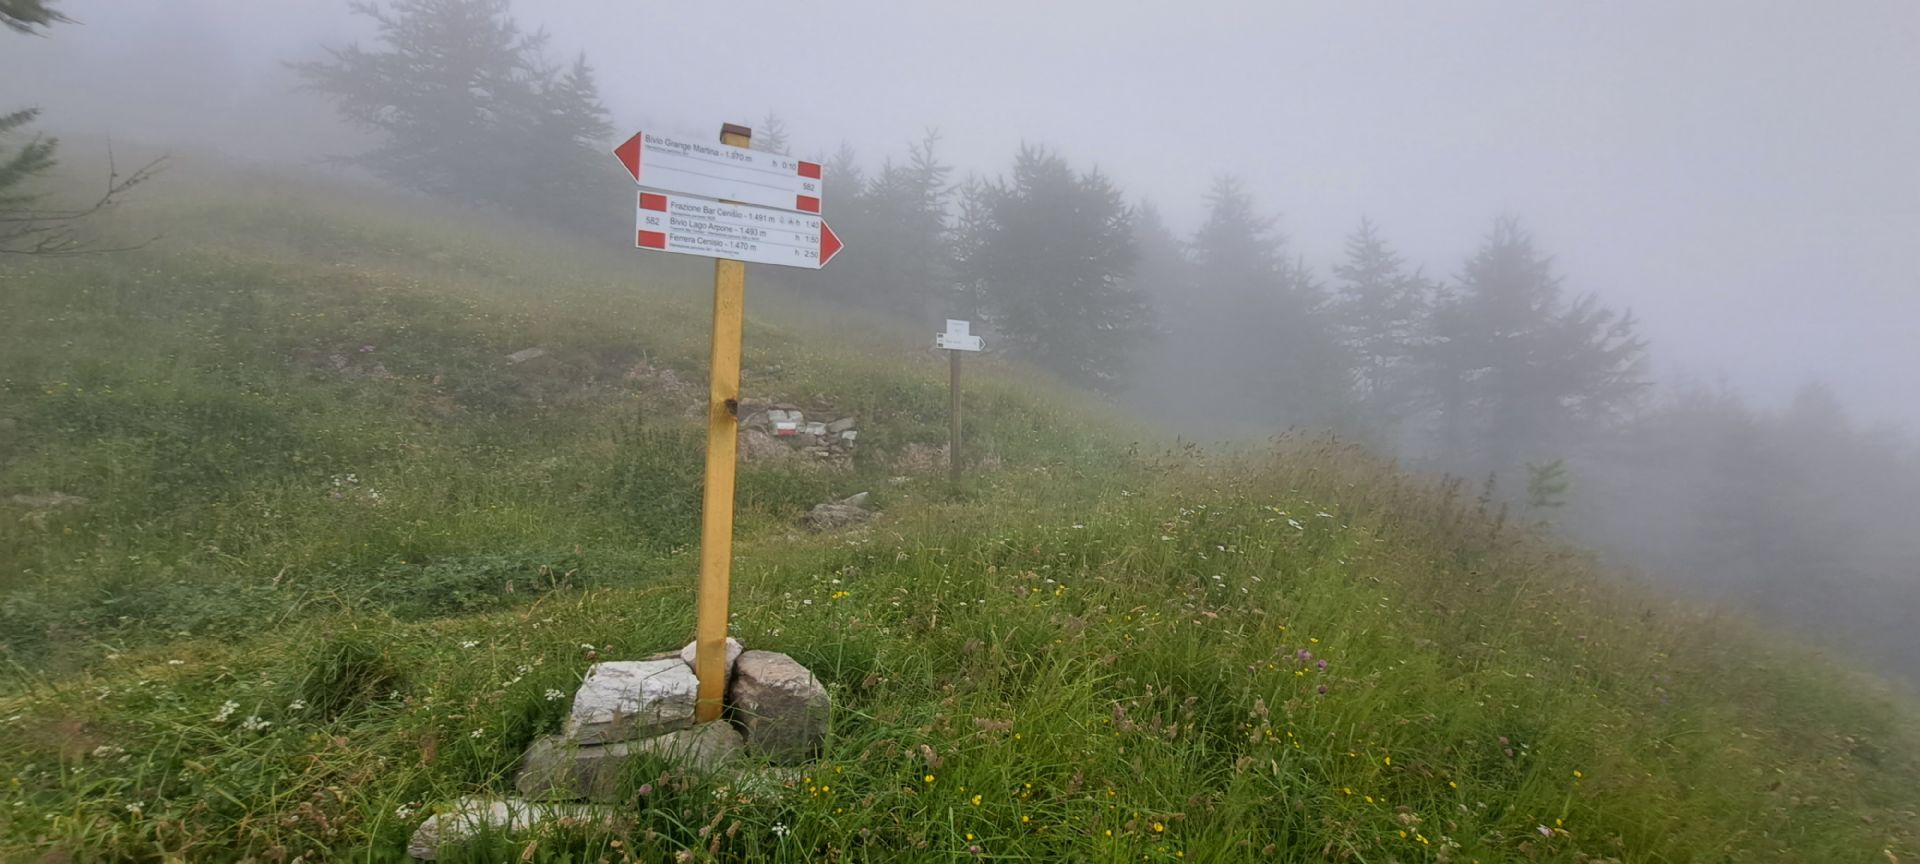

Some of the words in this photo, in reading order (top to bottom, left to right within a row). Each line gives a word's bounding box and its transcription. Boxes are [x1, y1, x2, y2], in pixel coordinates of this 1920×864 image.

[645, 134, 663, 145] Bivio
[665, 138, 692, 152] Grange
[693, 144, 720, 156] Martina
[803, 182, 815, 192] 582
[671, 201, 700, 213] Frazione
[703, 206, 716, 215] Bar
[717, 208, 743, 218] Cenisio
[646, 216, 660, 226] 582
[670, 217, 687, 227] Bivio
[689, 219, 707, 231] Lago
[708, 222, 733, 234] Arpone
[697, 235, 723, 247] Cenisio
